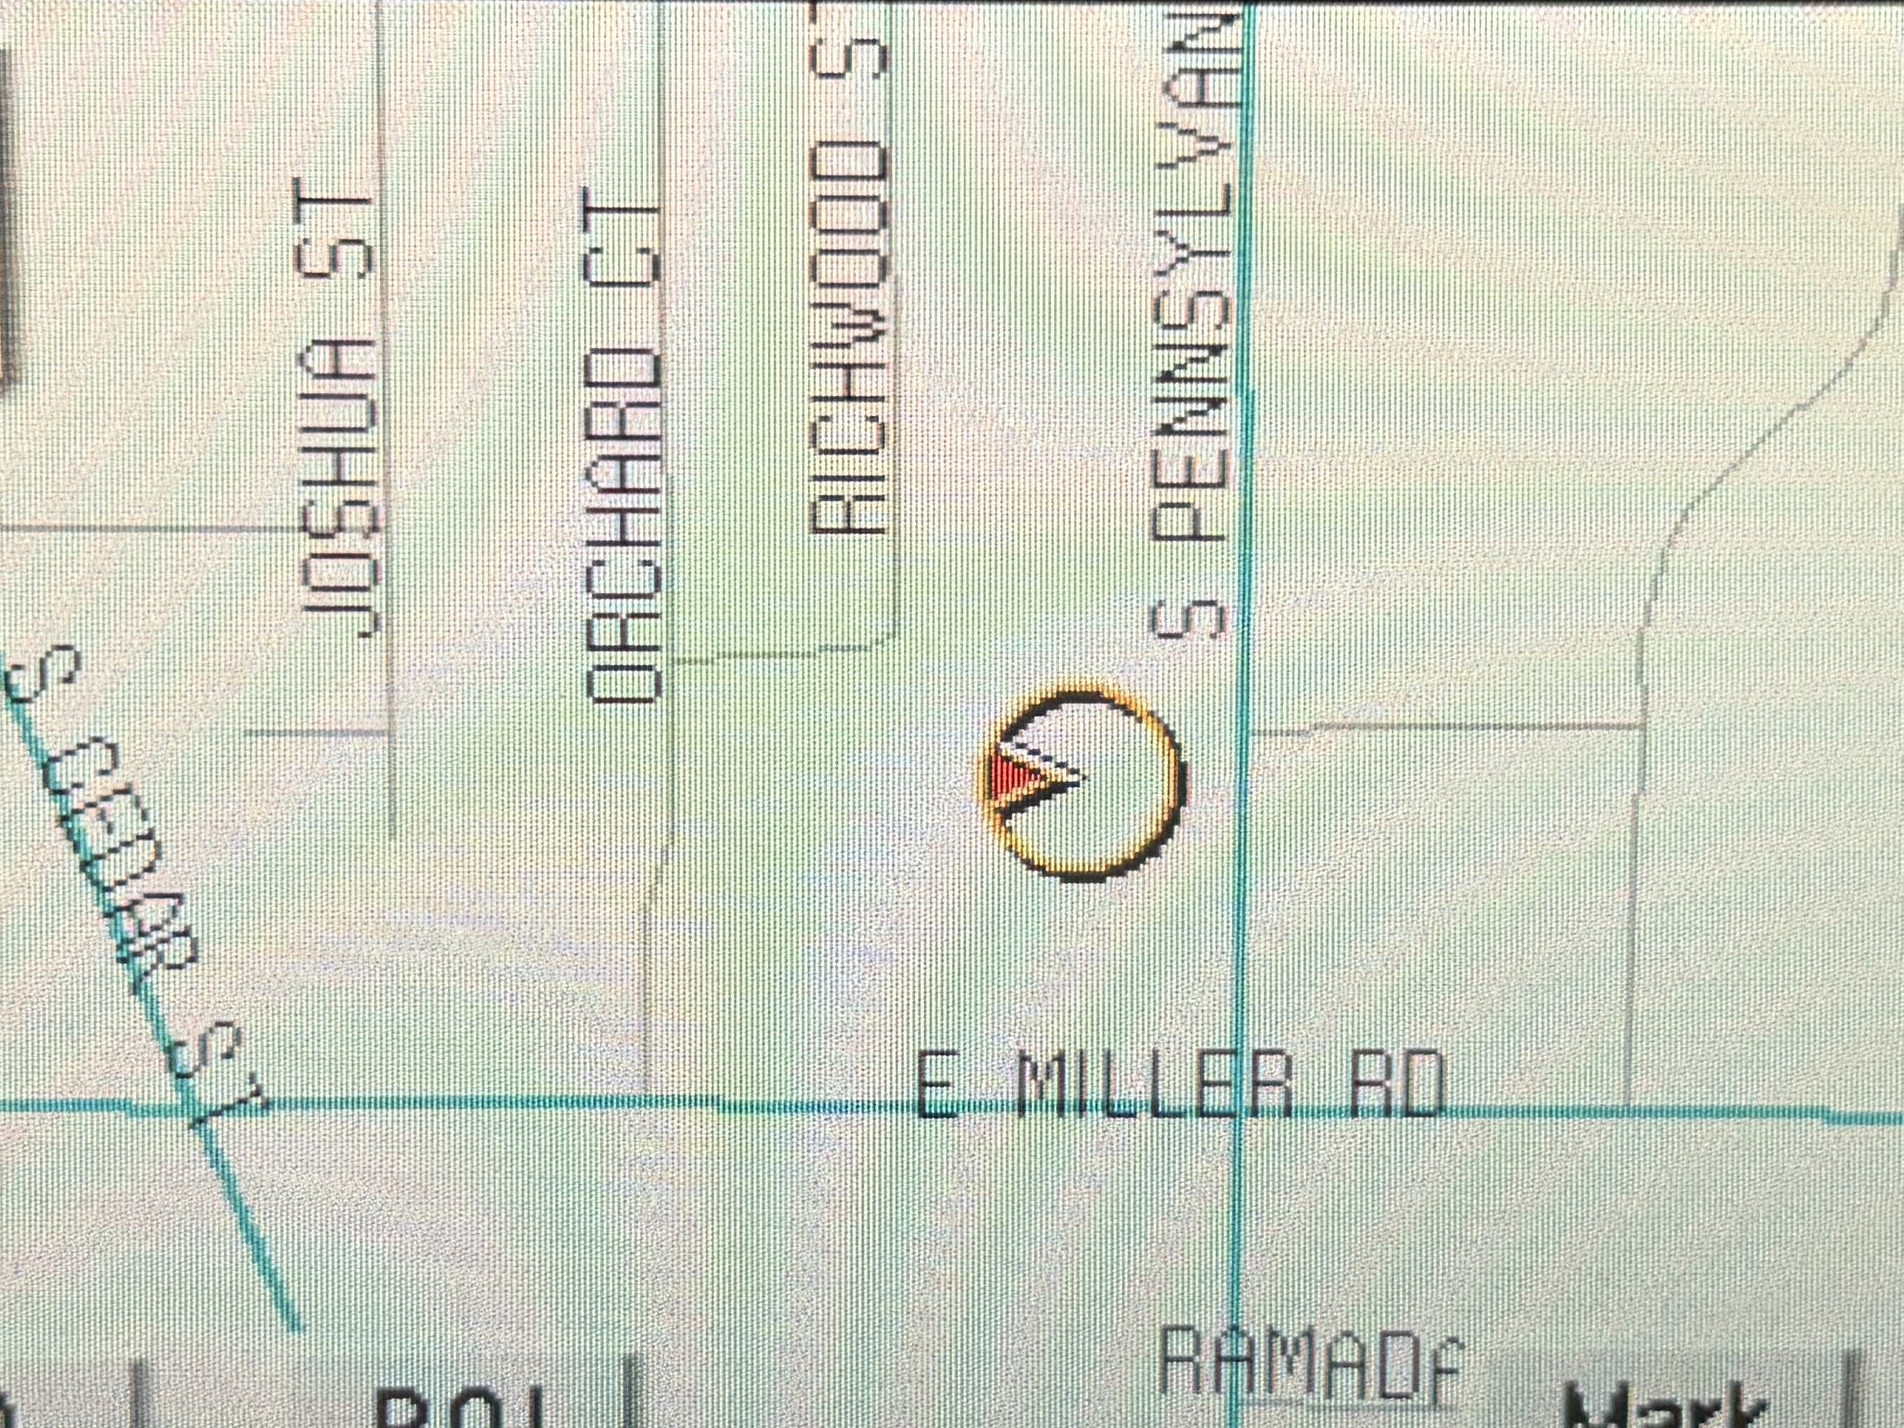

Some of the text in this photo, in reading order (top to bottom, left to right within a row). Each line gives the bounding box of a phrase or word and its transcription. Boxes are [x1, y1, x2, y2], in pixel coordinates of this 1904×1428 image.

[291, 176, 382, 640] JOSHUA ST
[580, 185, 663, 705] ORCHARD CT
[809, 139, 889, 537] RICHWOOD
[1148, 12, 1244, 640] S PENNSYLVAN
[5, 643, 270, 1131] S CEDAR ST
[917, 1047, 1448, 1119] E MILLER RD
